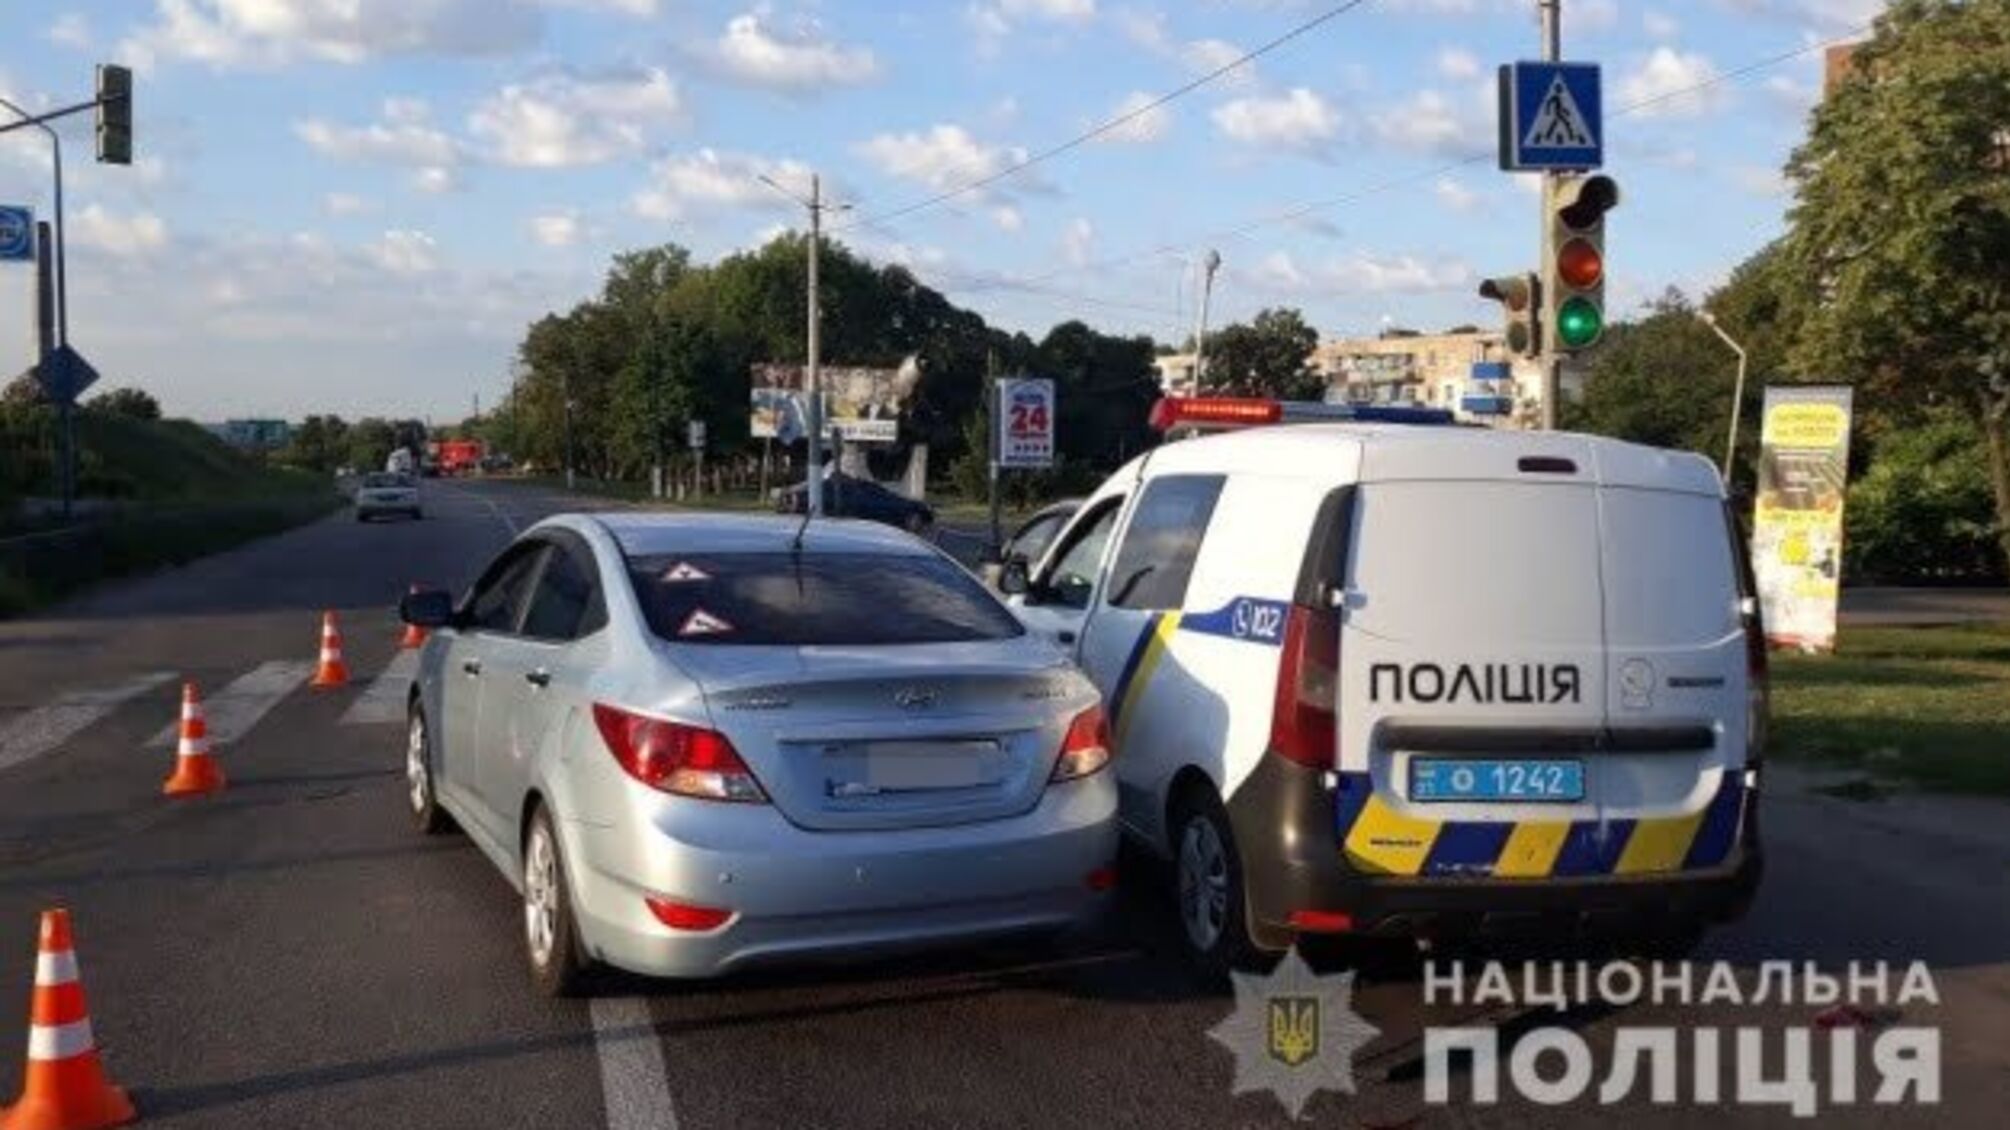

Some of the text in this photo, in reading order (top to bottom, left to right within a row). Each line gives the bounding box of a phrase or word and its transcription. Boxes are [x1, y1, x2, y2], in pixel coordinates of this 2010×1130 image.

[1010, 404, 1048, 432] 24
[1251, 605, 1281, 637] 102
[1370, 663, 1580, 704] ПОЛІЦІЯ
[1492, 765, 1563, 794] 1242
